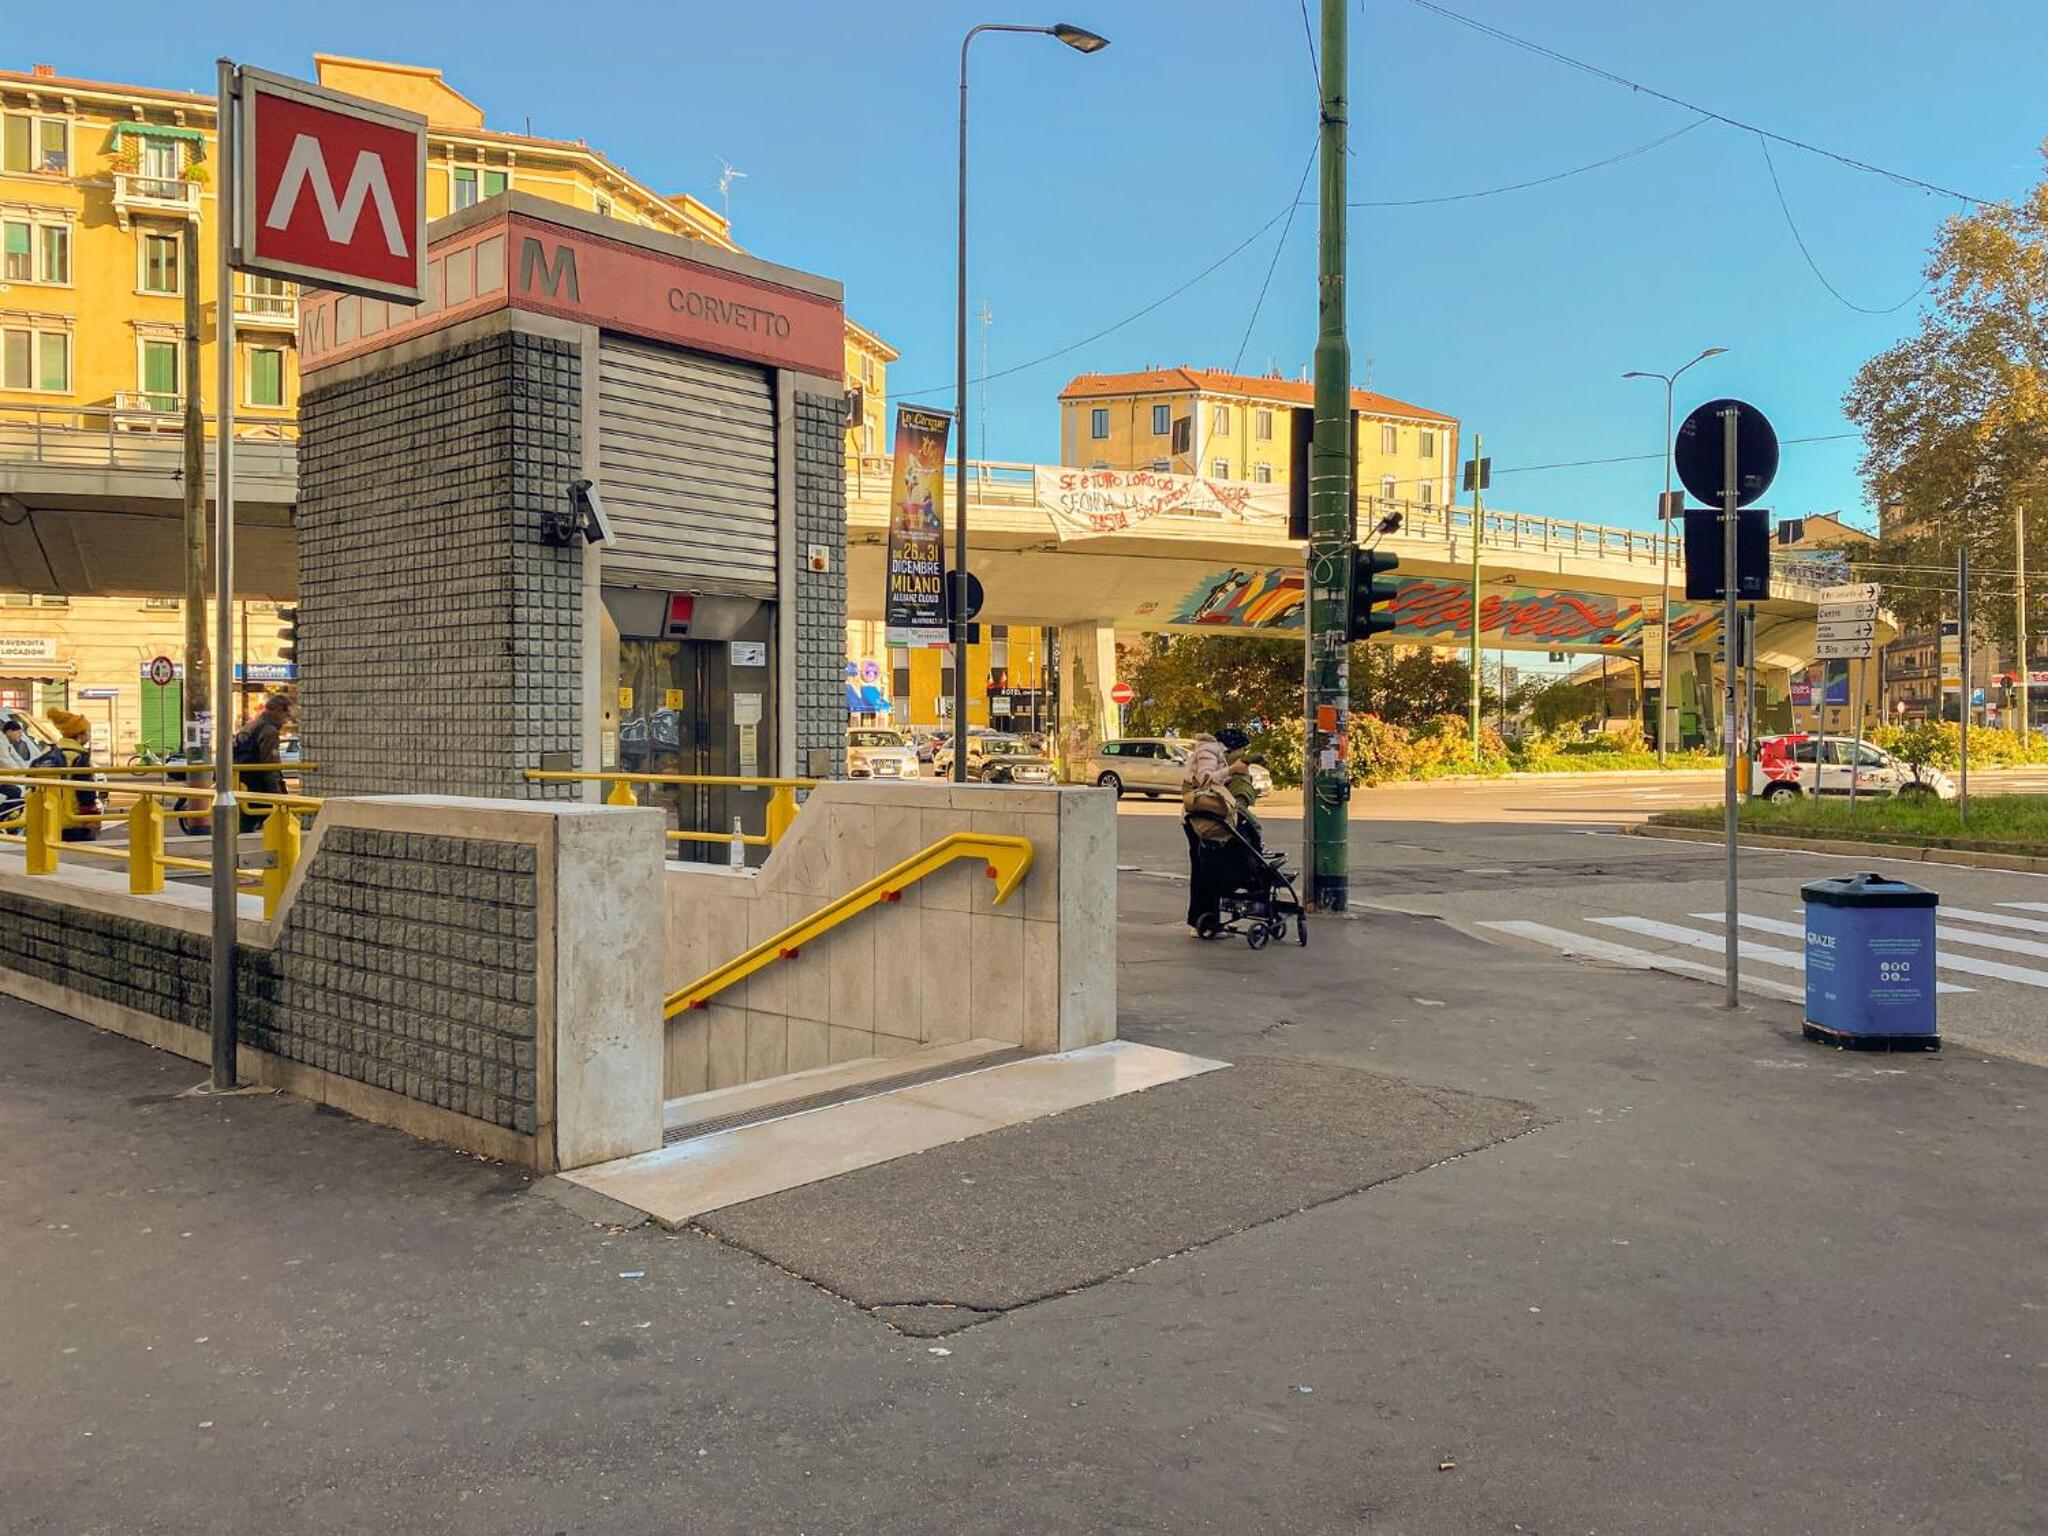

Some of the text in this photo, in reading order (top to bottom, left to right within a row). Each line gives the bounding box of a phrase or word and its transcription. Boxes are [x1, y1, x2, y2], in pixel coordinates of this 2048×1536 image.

[265, 134, 409, 258] M
[519, 237, 580, 304] M
[667, 287, 791, 339] CORVETTO
[891, 574, 940, 593] MILANO
[892, 560, 940, 575] DICEMBRE
